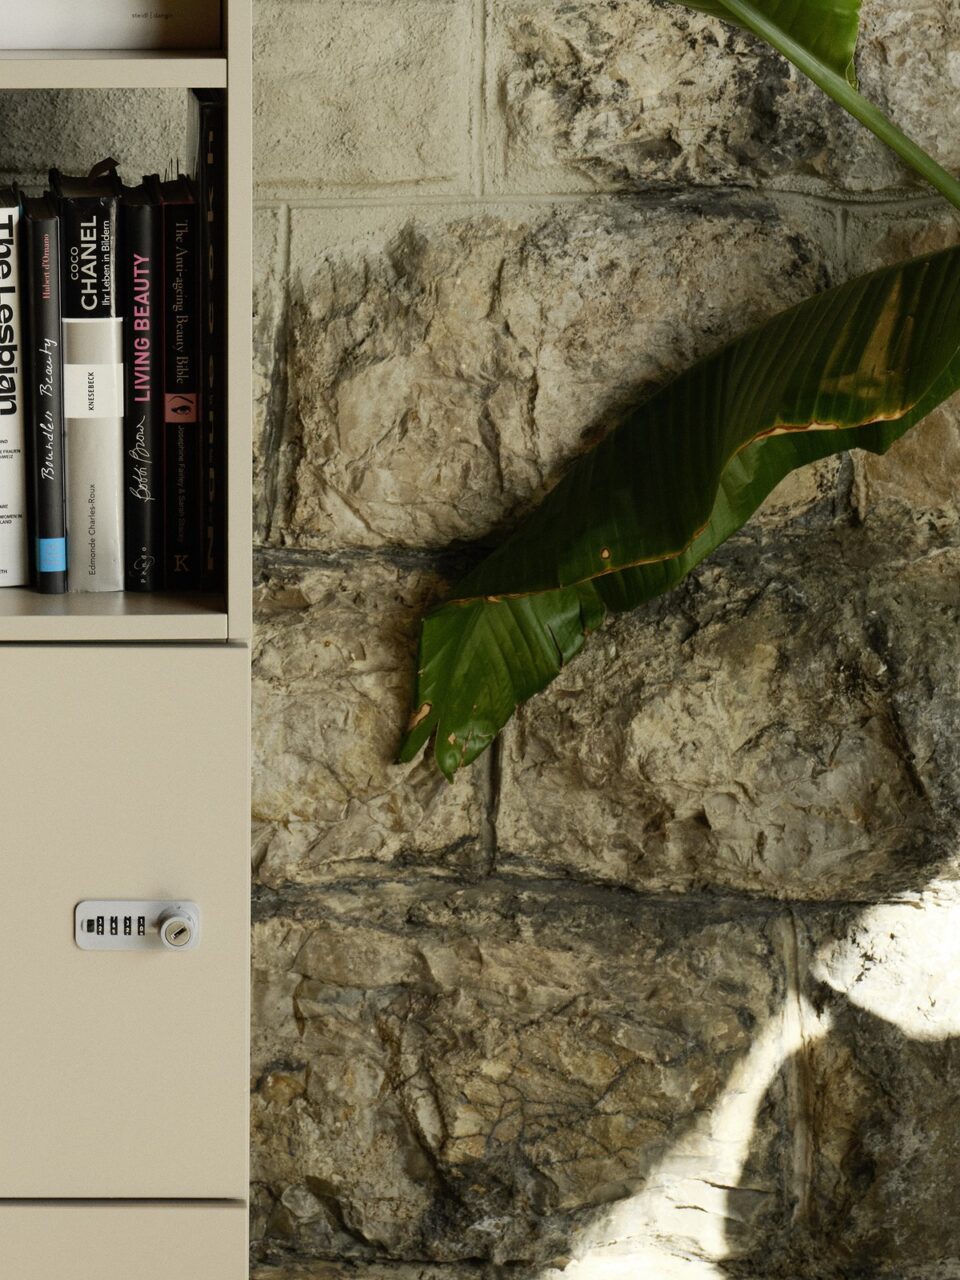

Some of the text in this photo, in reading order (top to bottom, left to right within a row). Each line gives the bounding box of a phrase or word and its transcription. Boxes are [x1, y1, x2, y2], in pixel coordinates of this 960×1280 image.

[70, 246, 79, 281] COCO
[80, 215, 98, 311] CHANEL
[172, 219, 189, 384] The Anti-ageing Beauty Bible
[40, 338, 57, 396] Beauty
[133, 253, 150, 402] LIVING BEAUTY
[88, 484, 96, 576] Edmonde Charles-Roux
[129, 466, 156, 503] Bobbi
